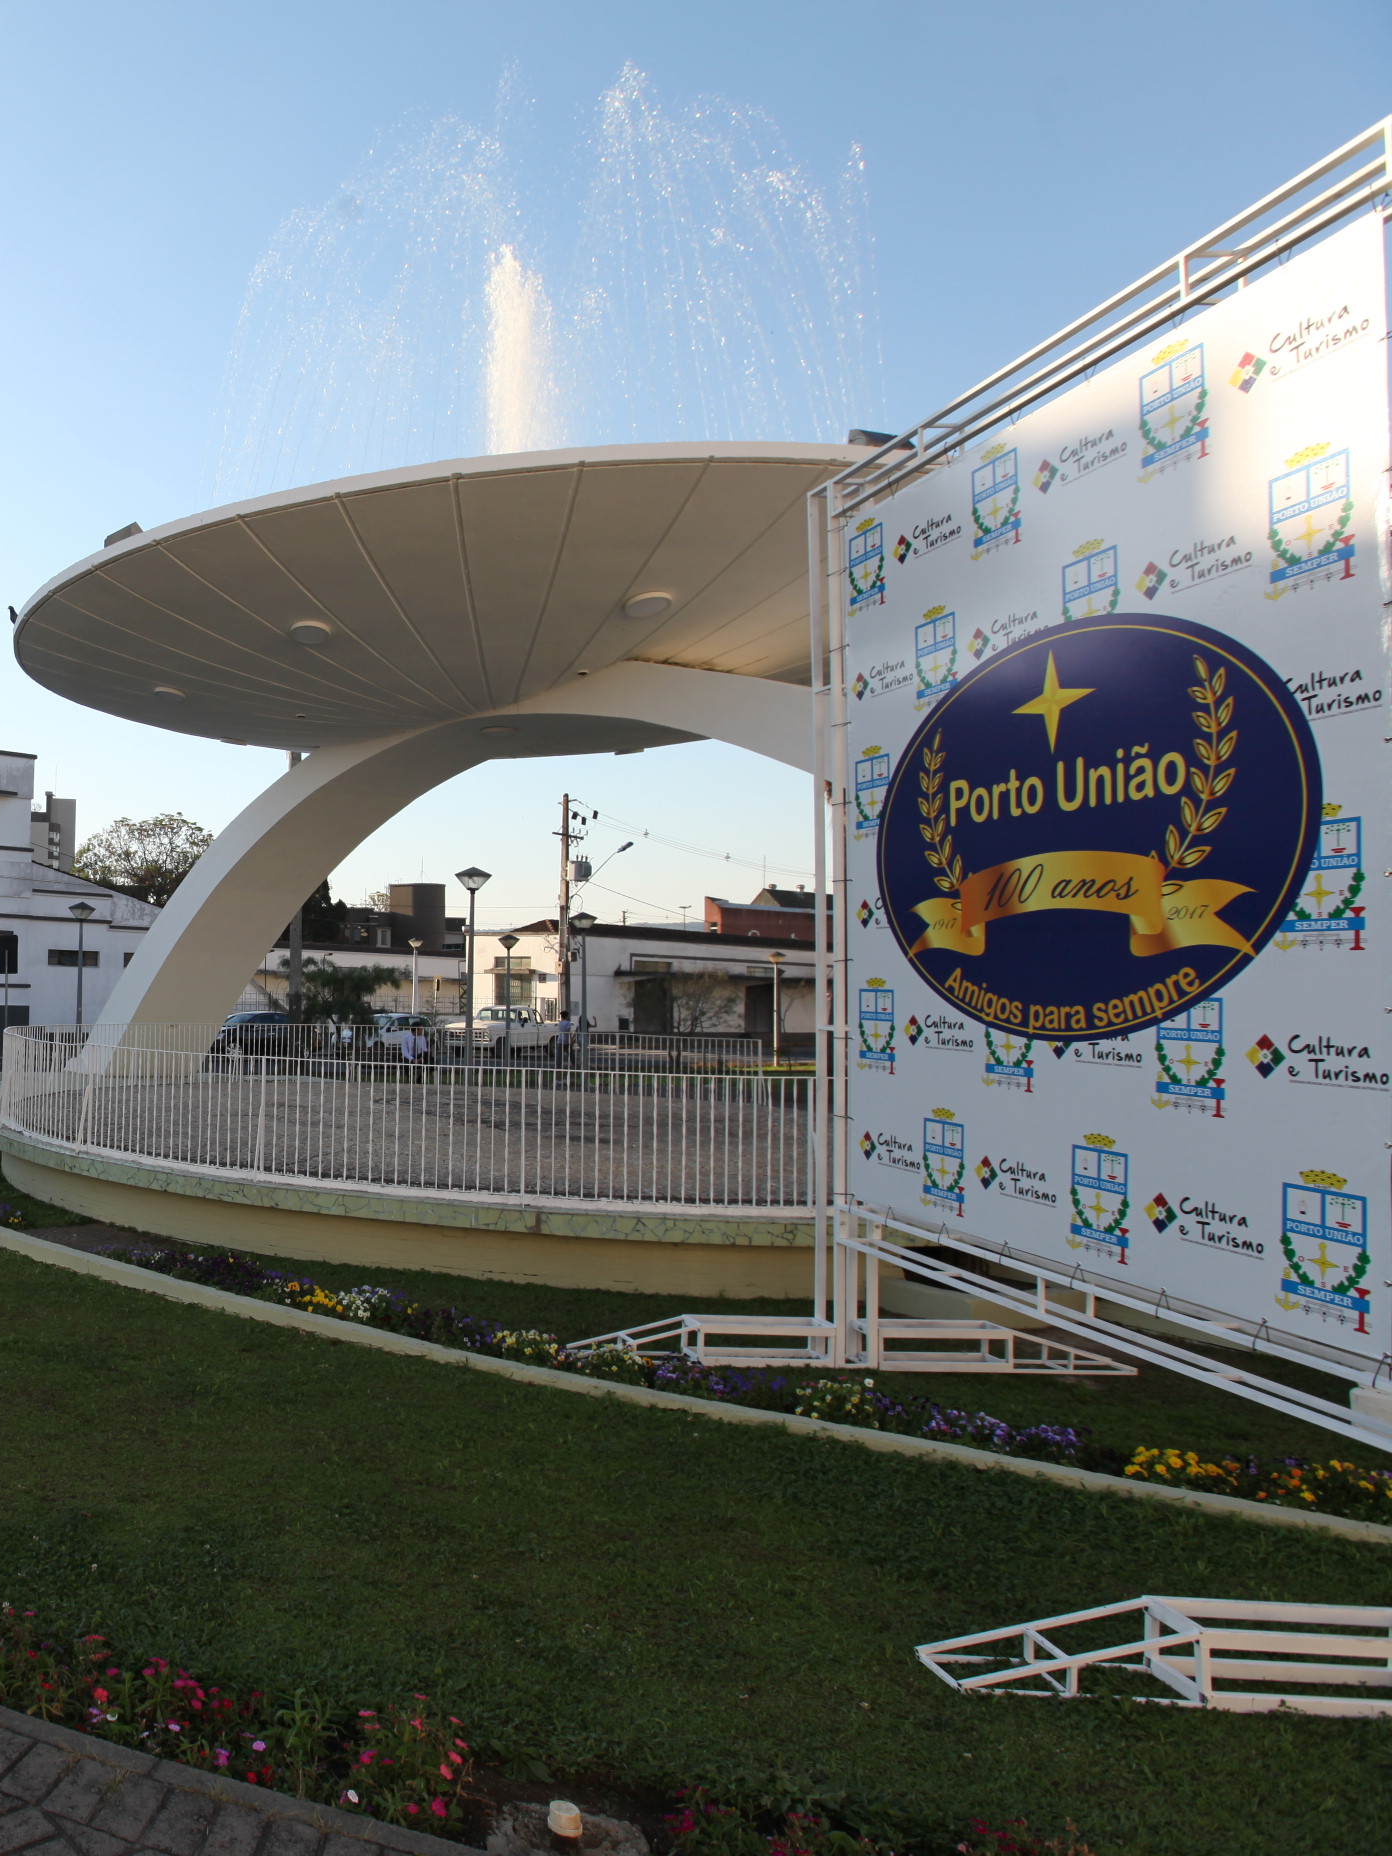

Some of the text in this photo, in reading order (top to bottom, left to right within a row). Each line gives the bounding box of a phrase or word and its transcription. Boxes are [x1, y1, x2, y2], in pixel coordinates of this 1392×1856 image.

[1269, 305, 1350, 353] Cultura
[1269, 365, 1282, 376] e
[1289, 318, 1370, 364] Turismo
[1059, 428, 1115, 463] Cultura
[1153, 435, 1198, 462] SEMPER
[1059, 473, 1069, 482] e
[1072, 442, 1127, 474] Turismo
[1272, 503, 1309, 524] PORTO
[912, 513, 952, 539] Cultura
[912, 547, 919, 555] e
[922, 525, 962, 550] Turismo
[1169, 535, 1236, 568] Cultura
[1169, 579, 1180, 589] e
[1185, 551, 1253, 582] Turismo
[1285, 552, 1339, 577] SEMPER
[991, 611, 1038, 635] Cultura
[991, 644, 999, 652] e
[870, 660, 905, 679] Cultura
[870, 686, 876, 694] e
[879, 673, 914, 691] Turismo
[924, 683, 950, 696] SEMPER
[1301, 690, 1382, 715] Turismo
[949, 743, 1186, 827] Porto União
[1322, 854, 1358, 867] UNIÃO
[983, 864, 1139, 911] 100 anos
[932, 918, 958, 931] 1917
[1166, 905, 1210, 921] 2017
[1295, 919, 1349, 930] SEMPER
[945, 966, 1201, 1034] Amigos para sempre
[924, 1014, 965, 1031] Cultura
[924, 1036, 931, 1044] e
[934, 1031, 974, 1049] Turismo
[1160, 1030, 1220, 1041] PORTO UNIÃO
[1287, 1034, 1371, 1059] Cultura
[865, 1052, 889, 1061] SEMPER
[1074, 1048, 1083, 1058] e
[1087, 1042, 1143, 1064] Turismo
[994, 1065, 1024, 1076] SEMPER
[1287, 1065, 1300, 1077] e
[1307, 1058, 1390, 1086] Turismo
[1168, 1084, 1212, 1097] SEMPER
[876, 1132, 913, 1153] Cultura
[877, 1152, 883, 1161] e
[886, 1149, 921, 1171] Turismo
[999, 1158, 1047, 1183] Cultura
[930, 1187, 957, 1201] SEMPER
[999, 1180, 1007, 1191] e
[1010, 1177, 1057, 1204] Turismo
[1074, 1175, 1125, 1193] PORTO UNIÃO
[1179, 1196, 1249, 1229] Cultura
[1080, 1227, 1118, 1245] SEMPER
[1179, 1224, 1189, 1236] e
[1195, 1220, 1264, 1255] Turismo
[1286, 1220, 1364, 1245] PORTO UNIÃO
[1297, 1285, 1353, 1308] SEMPER
